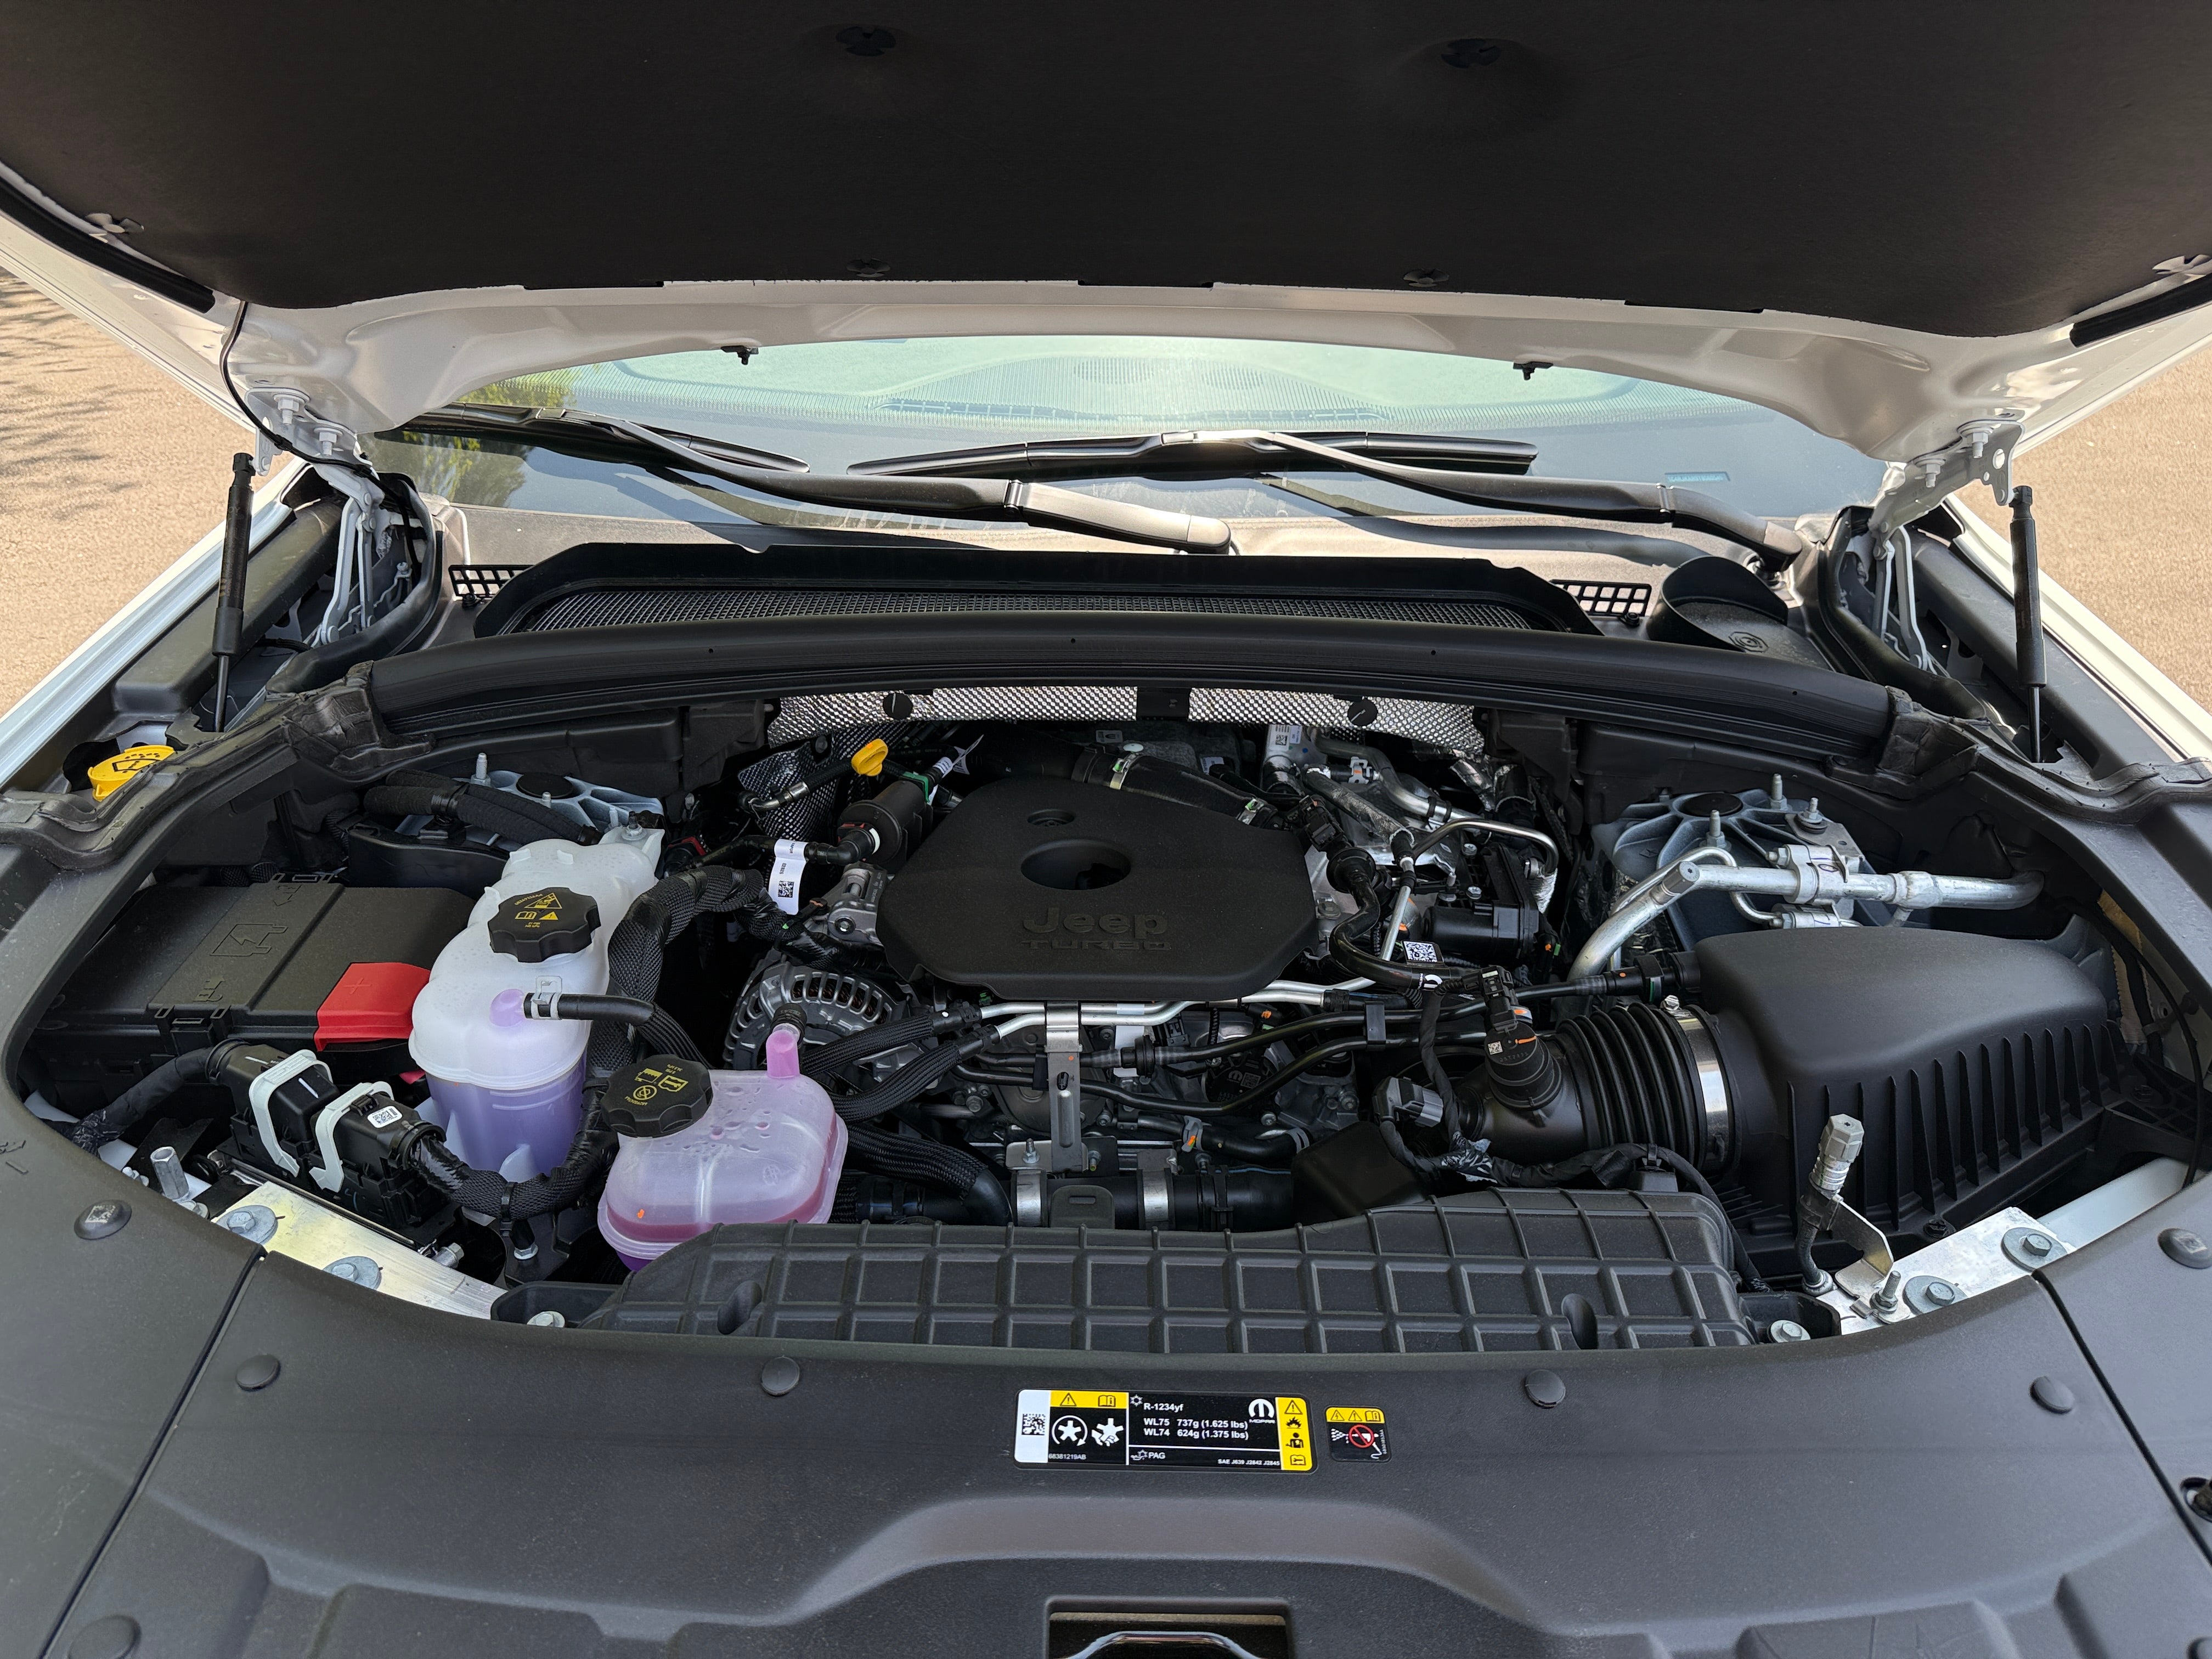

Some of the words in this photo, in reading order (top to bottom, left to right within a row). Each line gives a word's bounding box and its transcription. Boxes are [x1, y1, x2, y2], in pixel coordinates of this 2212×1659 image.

[1023, 907, 1169, 940] Jeep
[1020, 939, 1172, 952] TURBO
[1143, 1402, 1184, 1413] R-1234yf
[1143, 1418, 1170, 1426] WL75
[1177, 1419, 1199, 1429] 737g
[1201, 1419, 1229, 1429] (1.625
[1231, 1420, 1249, 1430] lbs)
[1143, 1427, 1170, 1436] WL74
[1177, 1429, 1200, 1439] 624g
[1201, 1430, 1229, 1440] (1.375
[1231, 1430, 1249, 1441] lbs)
[1148, 1452, 1166, 1460] PAG
